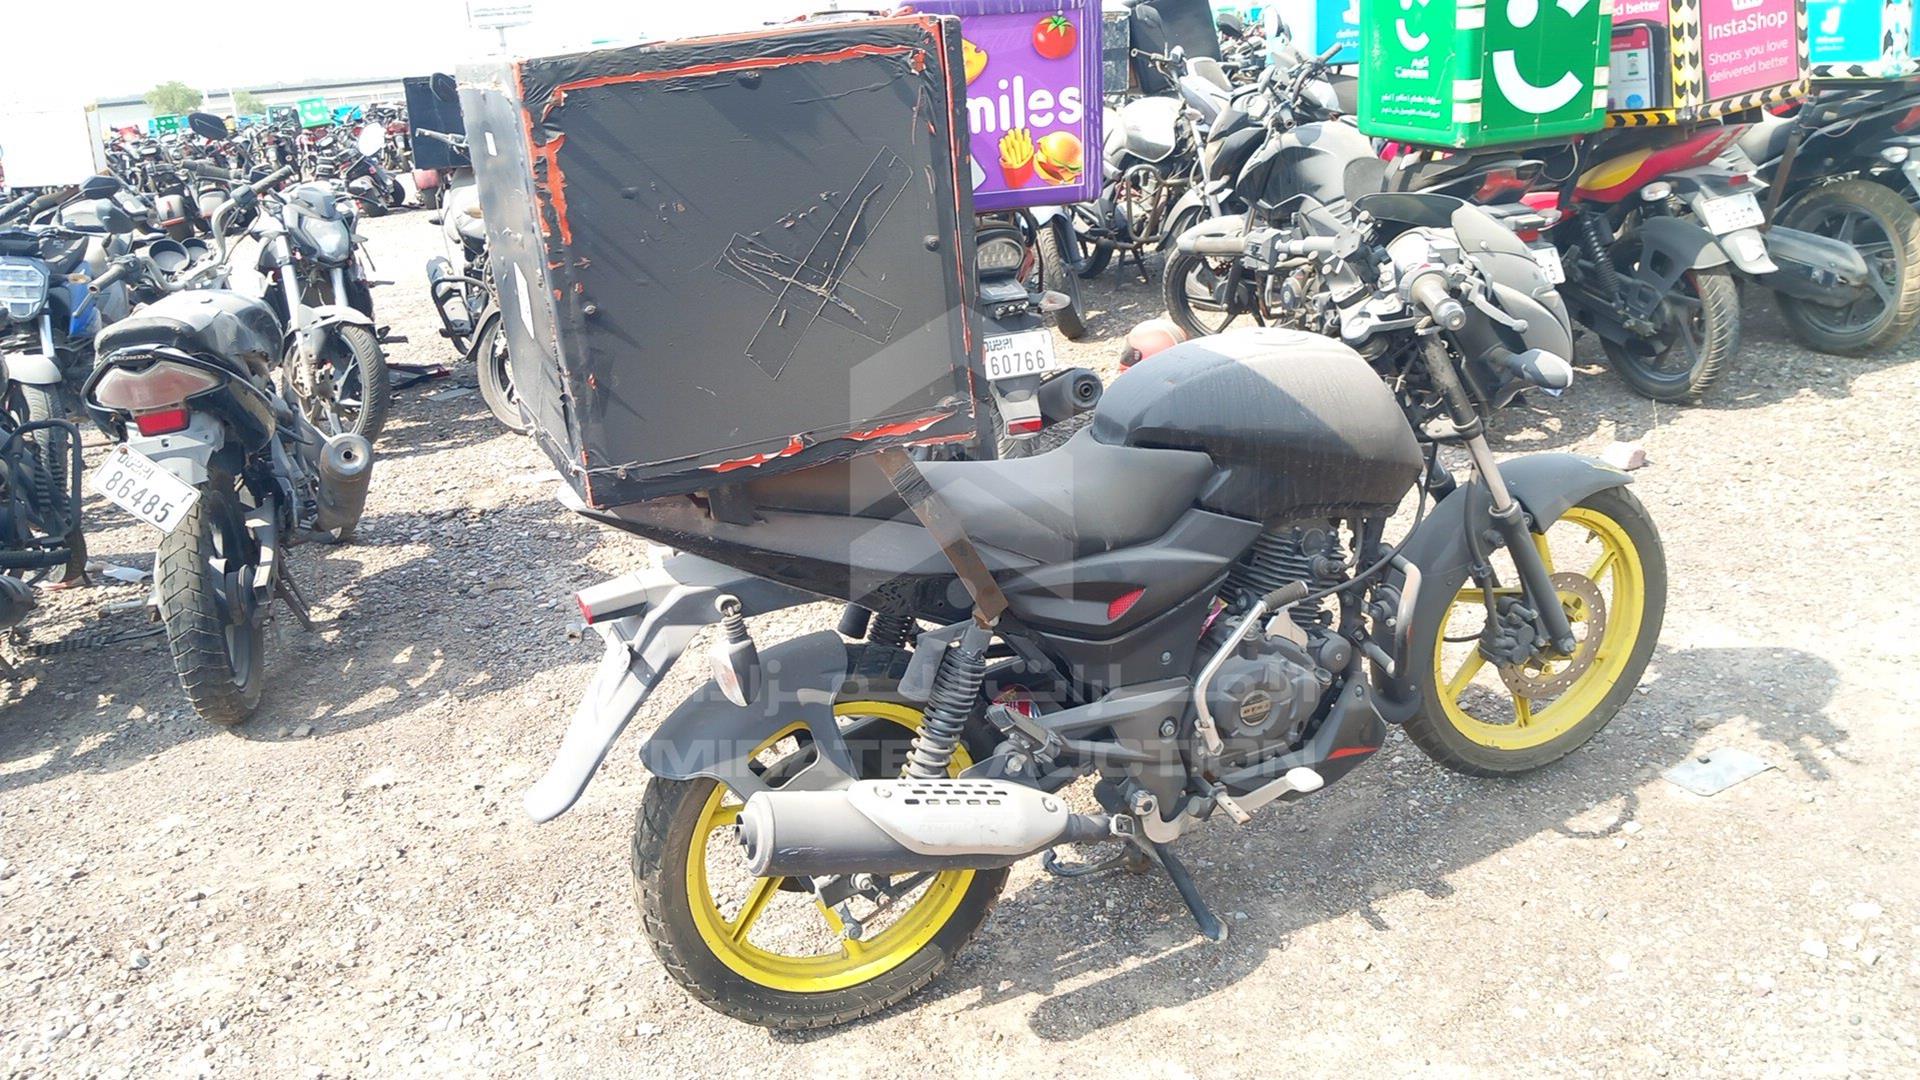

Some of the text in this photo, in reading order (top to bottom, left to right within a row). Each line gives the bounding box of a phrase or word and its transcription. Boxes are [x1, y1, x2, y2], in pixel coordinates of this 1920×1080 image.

[1626, 1, 1660, 15] better
[1708, 11, 1788, 40] InstaShop
[1709, 39, 1789, 66] Shops you love
[1709, 56, 1789, 83] delivered better
[990, 350, 1046, 376] 60766
[105, 470, 175, 523] 86485
